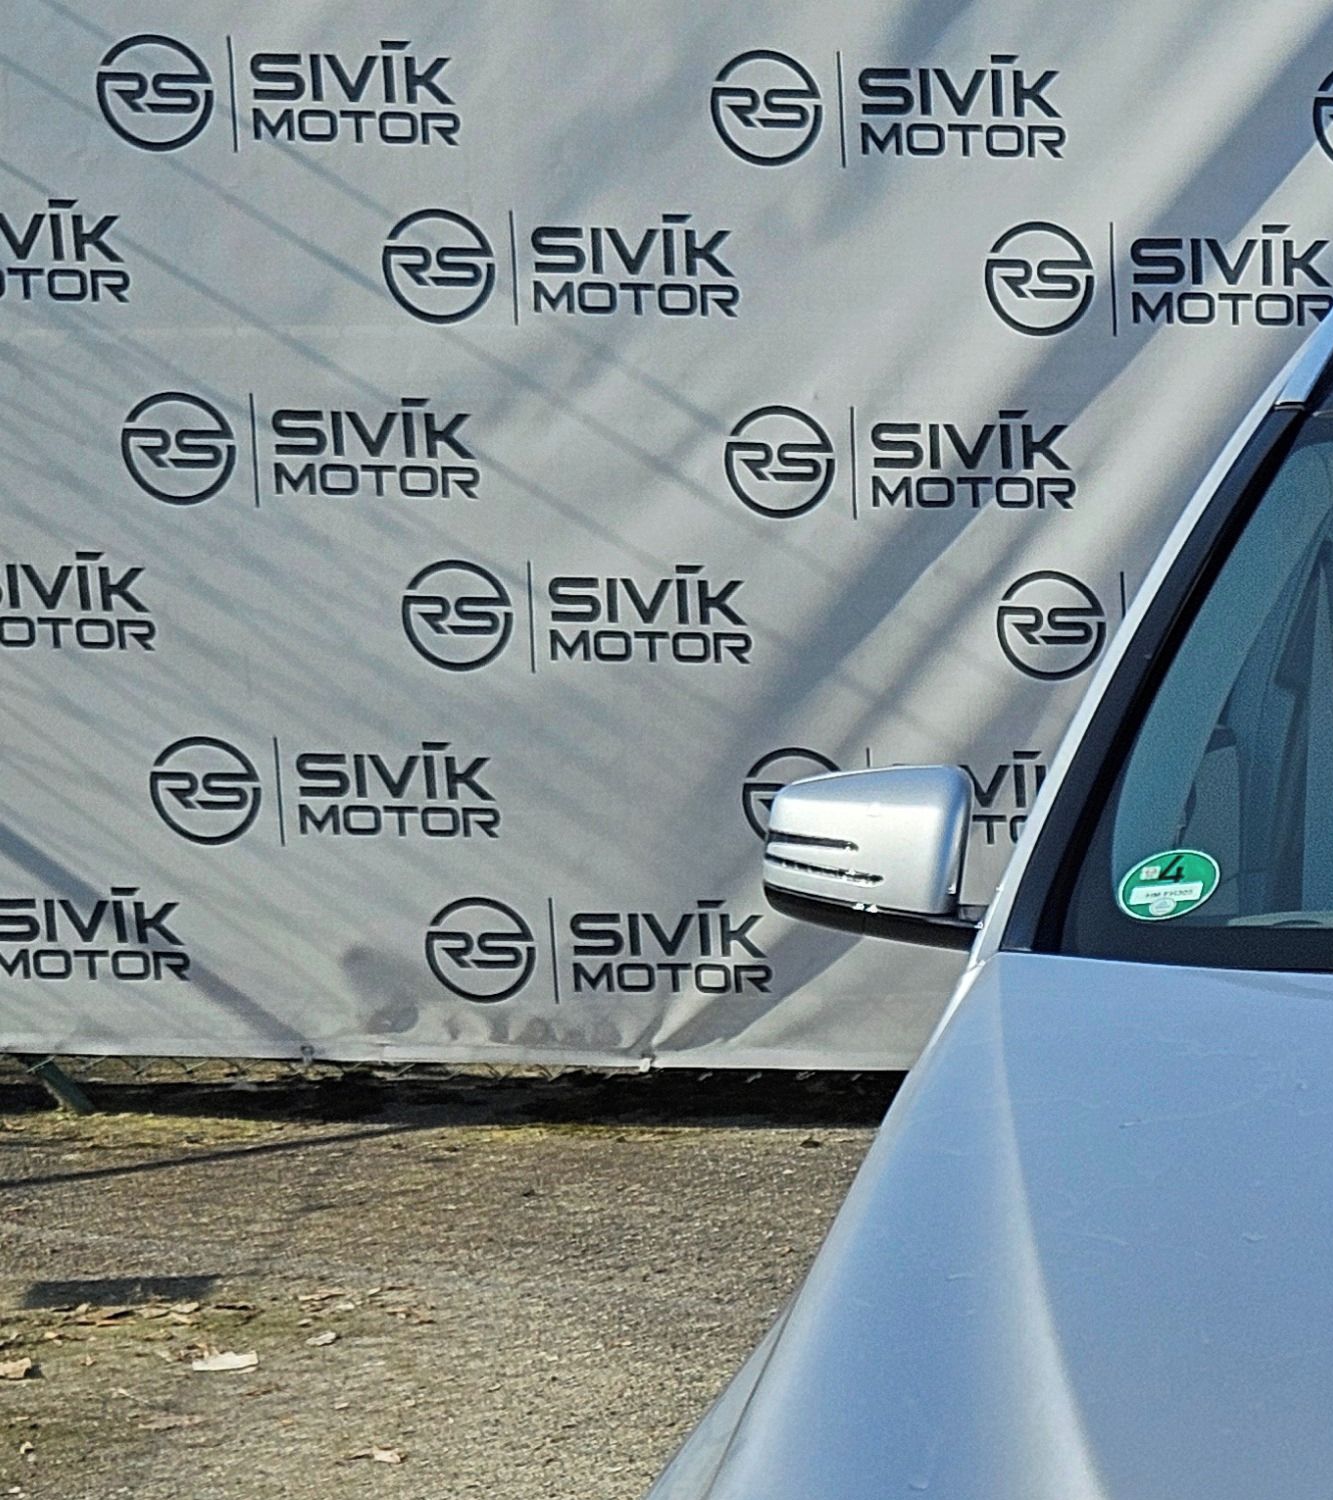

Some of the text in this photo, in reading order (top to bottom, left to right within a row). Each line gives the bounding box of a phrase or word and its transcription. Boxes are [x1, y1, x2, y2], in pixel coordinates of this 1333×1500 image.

[252, 108, 460, 146] MOTOR
[860, 122, 1066, 158] MOTOR
[0, 267, 130, 302] TOR
[533, 280, 739, 317] MOTOR
[274, 462, 480, 499] MOTOR
[872, 475, 1076, 509] MOTOR
[0, 616, 156, 651] OTOR
[549, 629, 752, 664] MOTOR
[298, 804, 500, 838] MOTOR
[1159, 855, 1184, 882] 4
[0, 948, 191, 981] MOTOR
[572, 962, 772, 993] MOTOR
